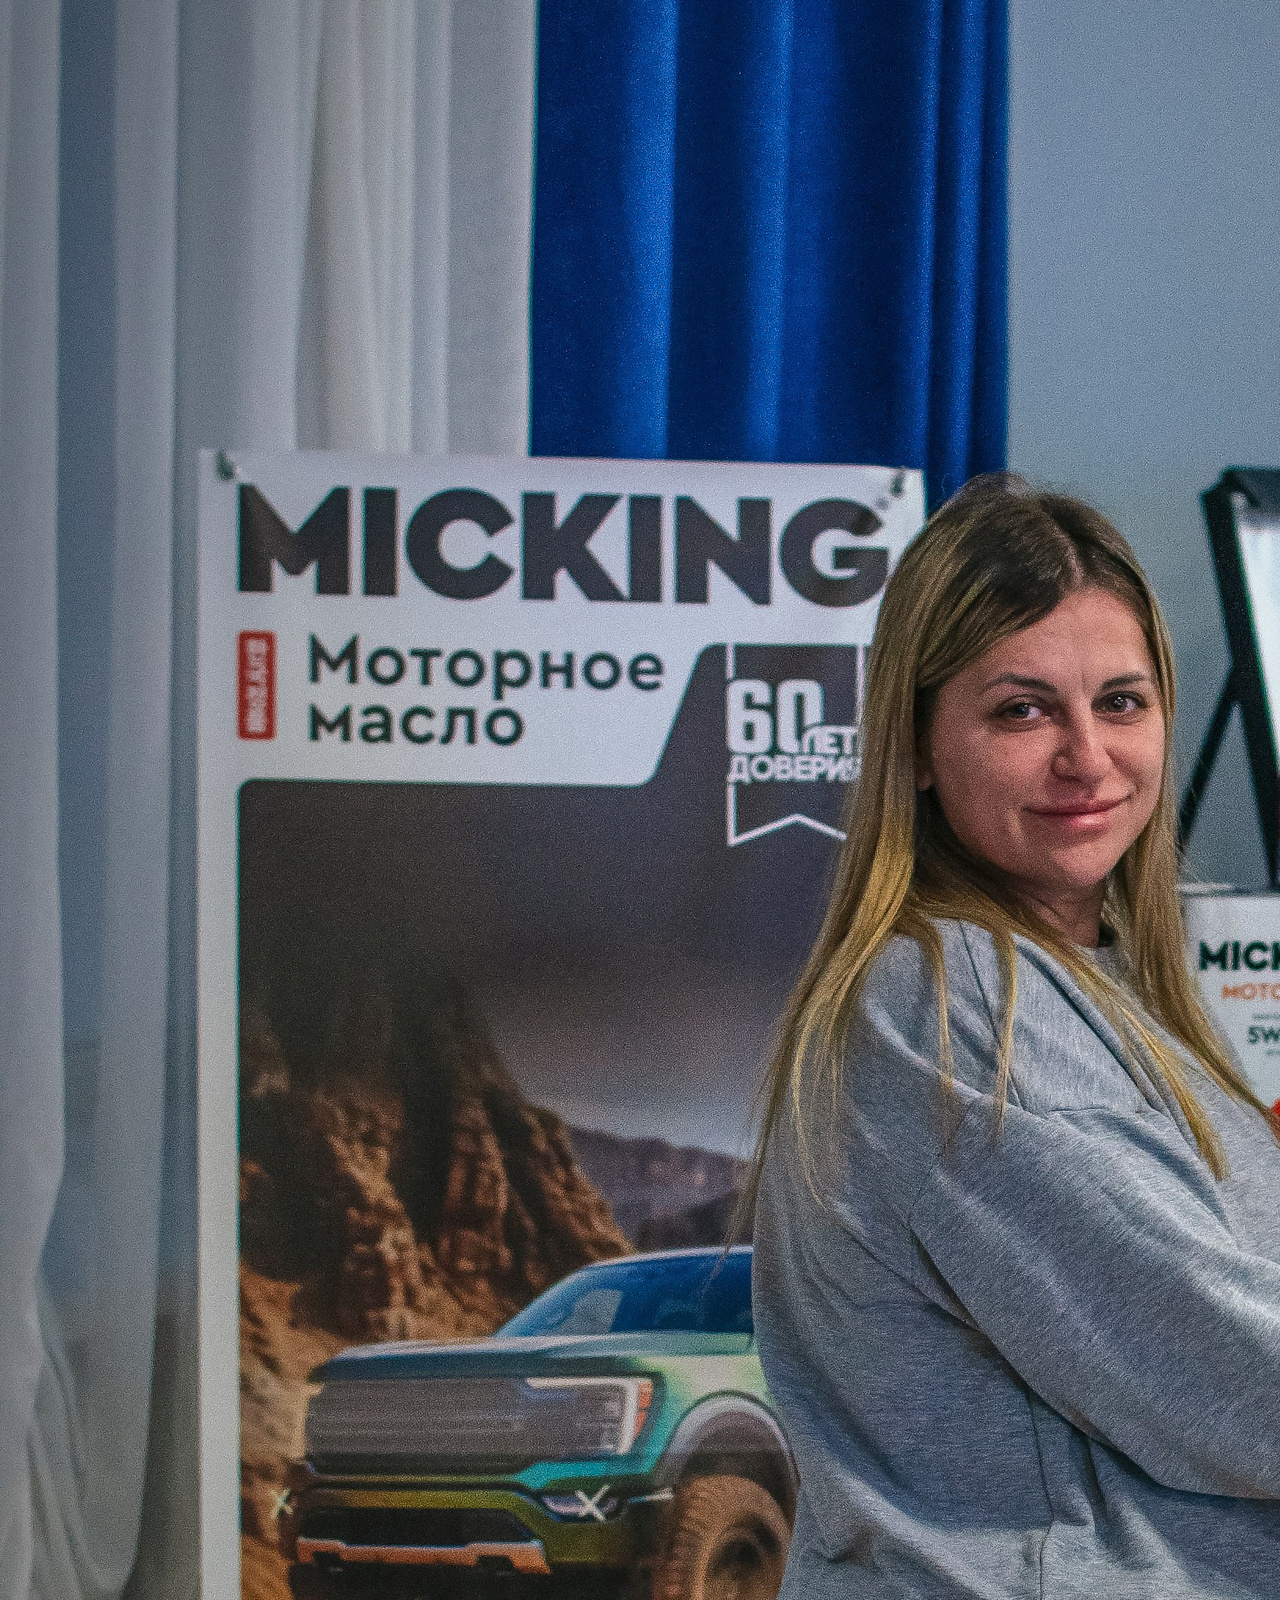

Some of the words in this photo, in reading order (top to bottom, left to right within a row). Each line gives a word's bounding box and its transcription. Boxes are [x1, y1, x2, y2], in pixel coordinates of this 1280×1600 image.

[237, 483, 890, 607] MICKING
[308, 633, 664, 699] Моторное
[308, 704, 525, 746] масло
[727, 679, 825, 754] 60
